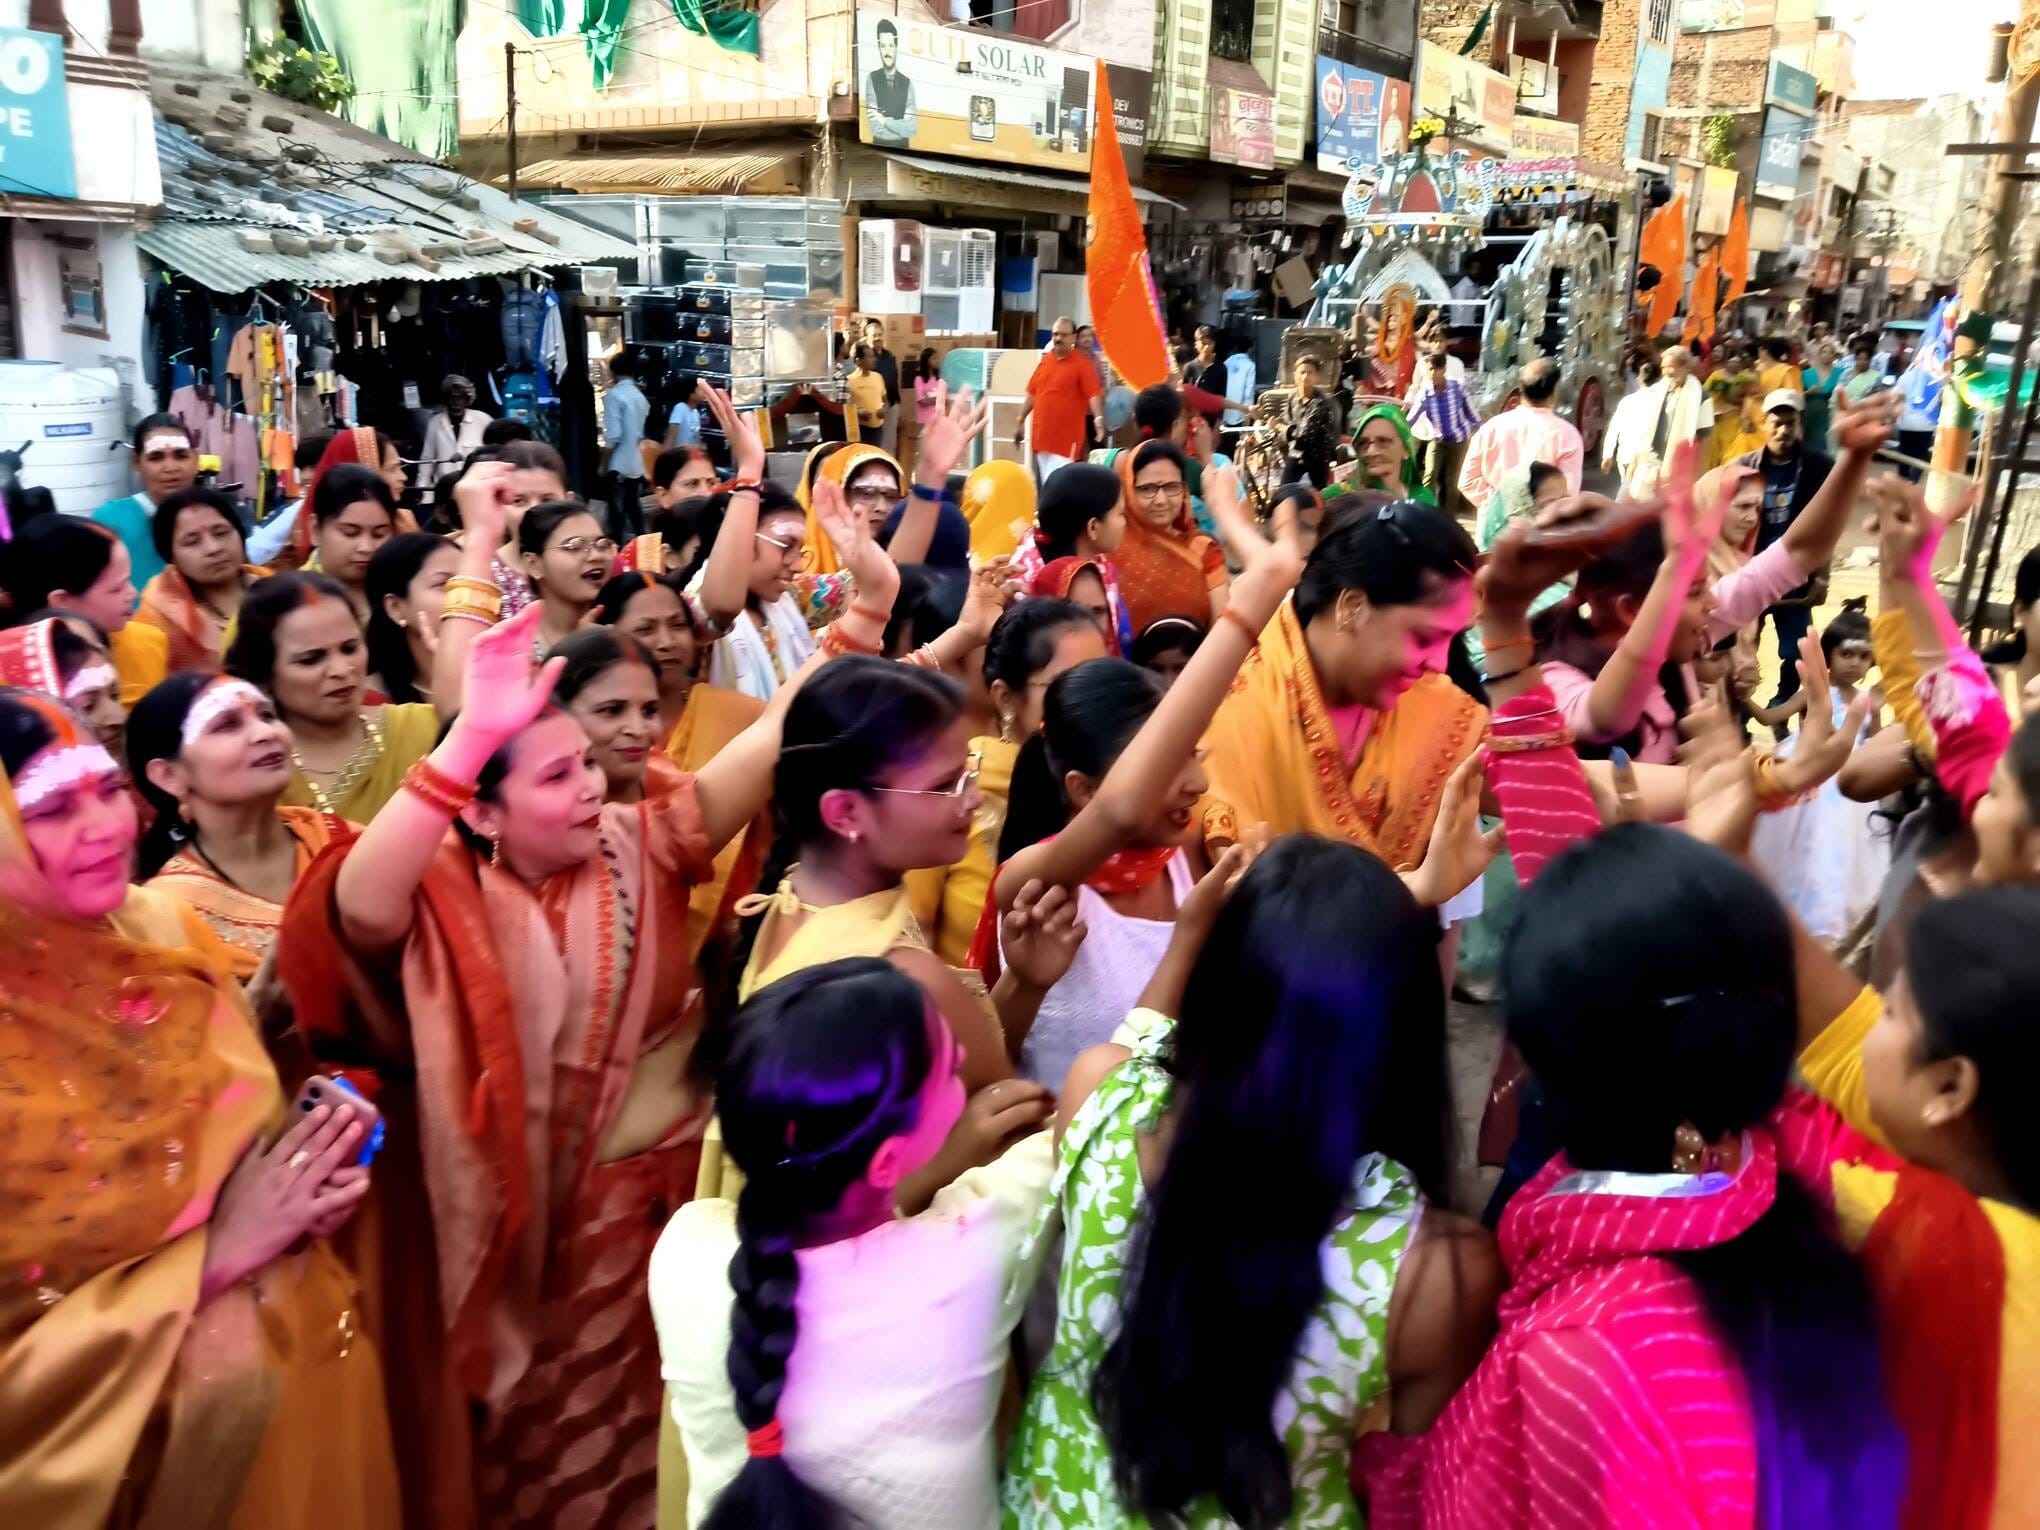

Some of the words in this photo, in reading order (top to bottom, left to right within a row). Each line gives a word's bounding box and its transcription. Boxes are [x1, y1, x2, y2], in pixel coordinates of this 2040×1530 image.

[977, 43, 1046, 78] SOLAR
[1113, 98, 1130, 112] DEV
[1348, 79, 1375, 115] TT
[1112, 114, 1145, 131] TRONICS
